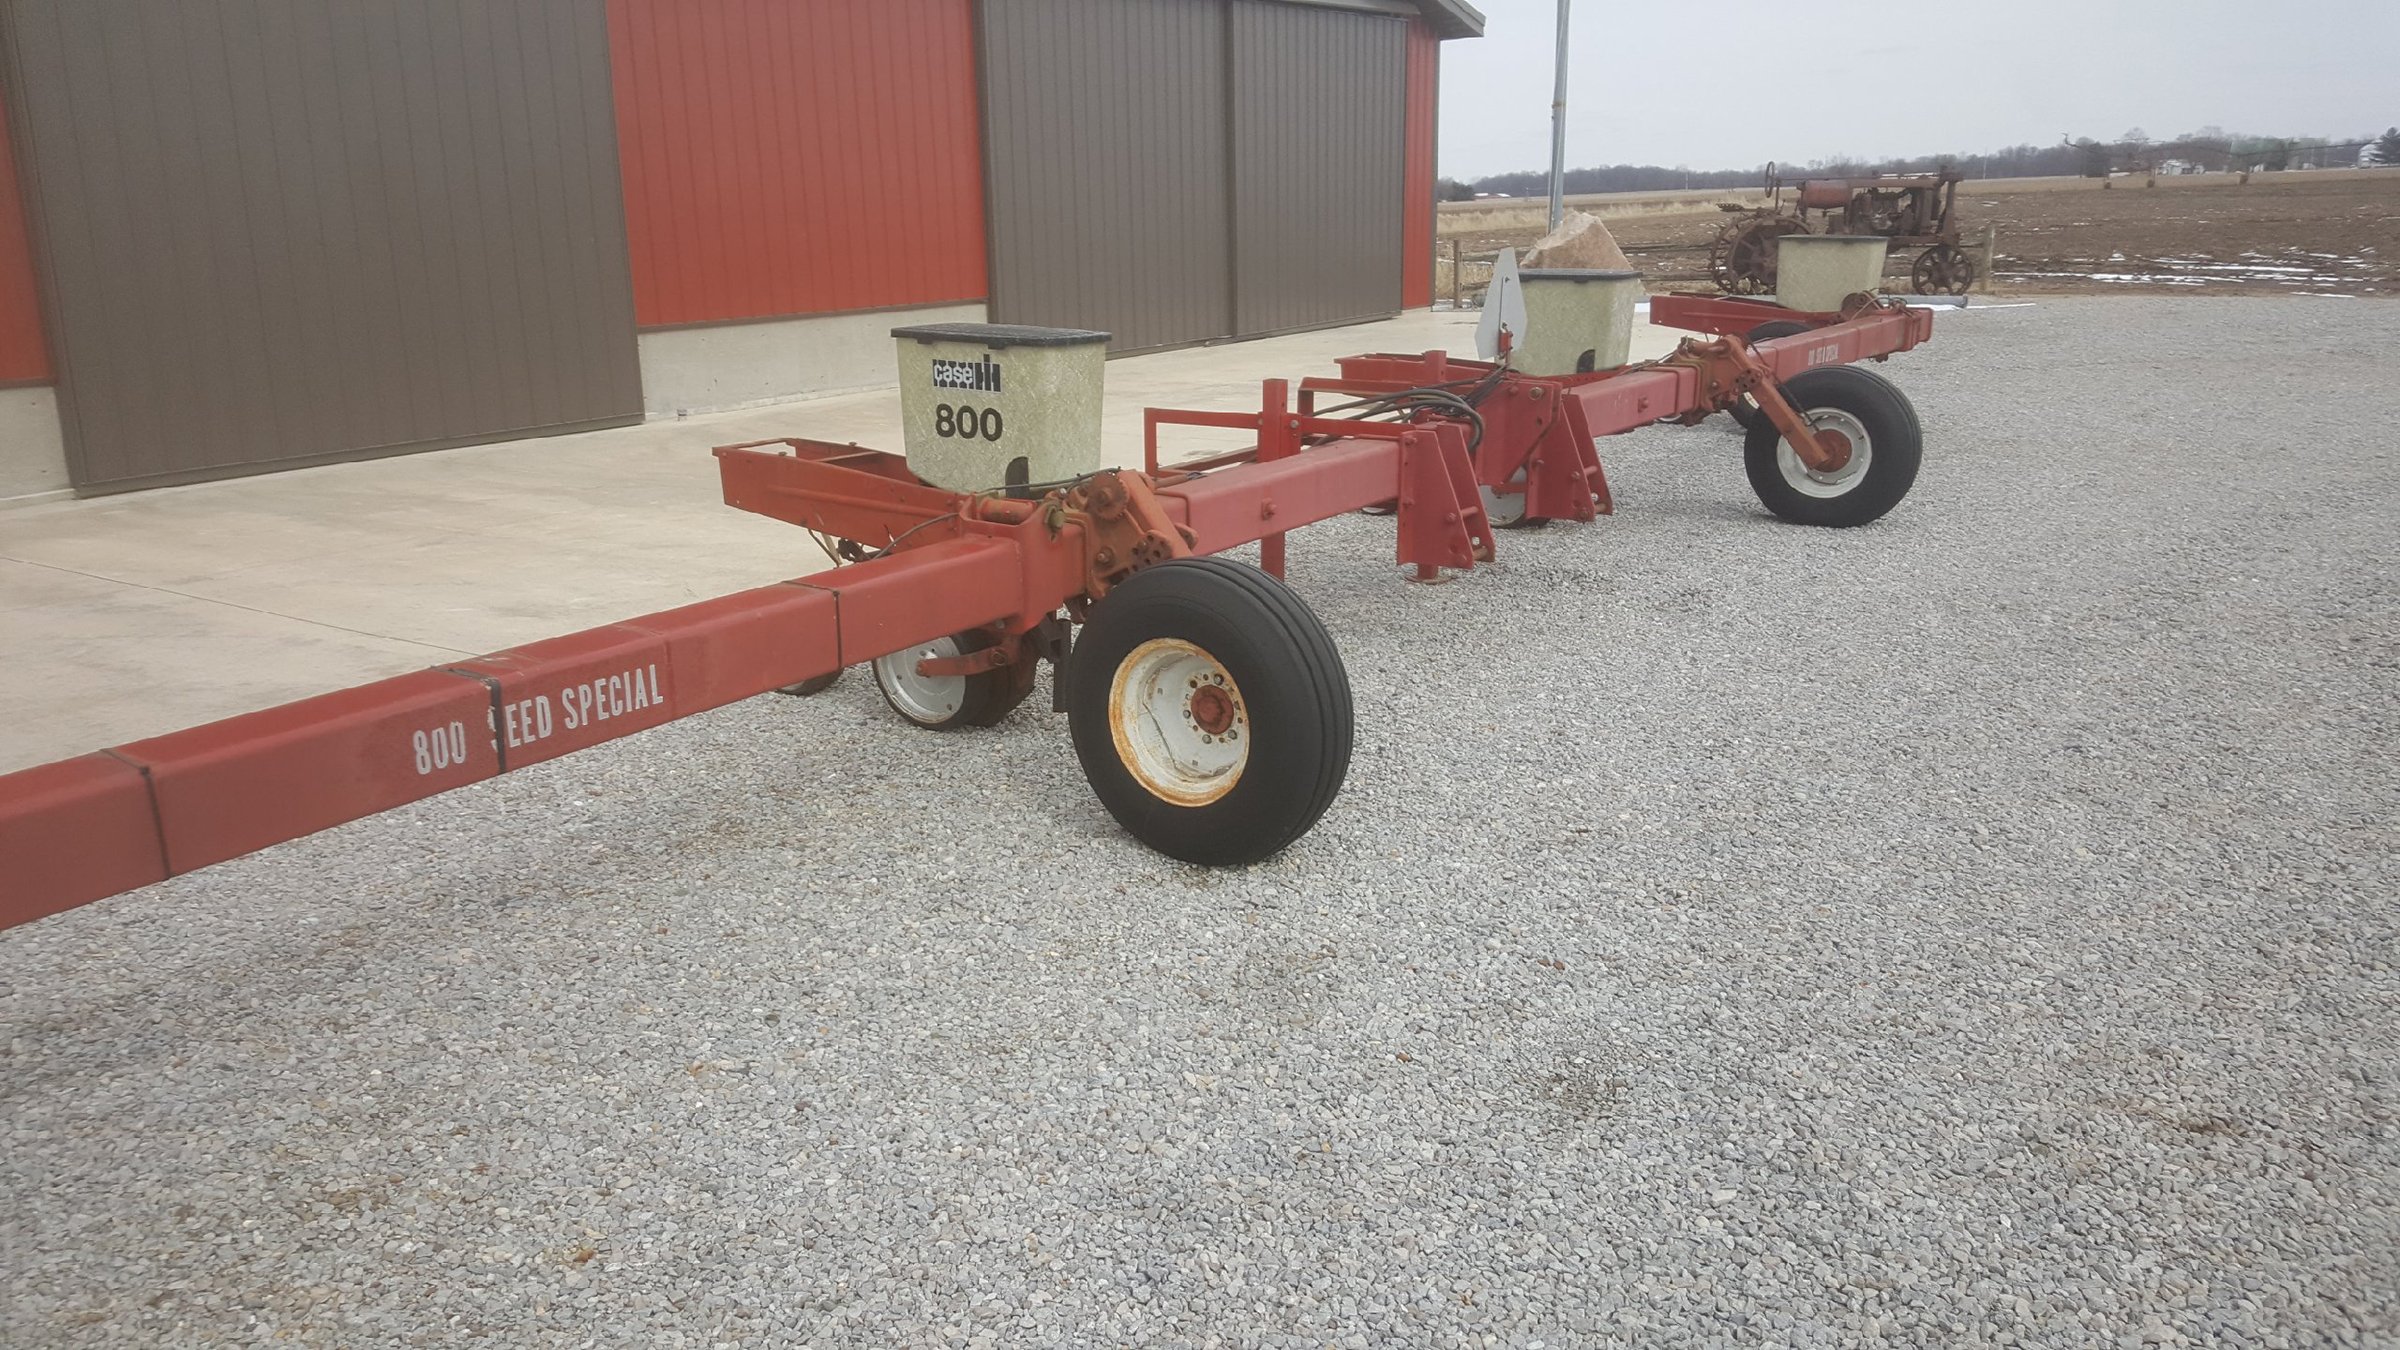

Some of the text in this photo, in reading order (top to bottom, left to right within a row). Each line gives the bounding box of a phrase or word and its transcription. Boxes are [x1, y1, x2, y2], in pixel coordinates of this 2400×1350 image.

[935, 403, 1003, 442] 800
[412, 720, 466, 775] 800
[561, 664, 664, 730] SPECIAL
